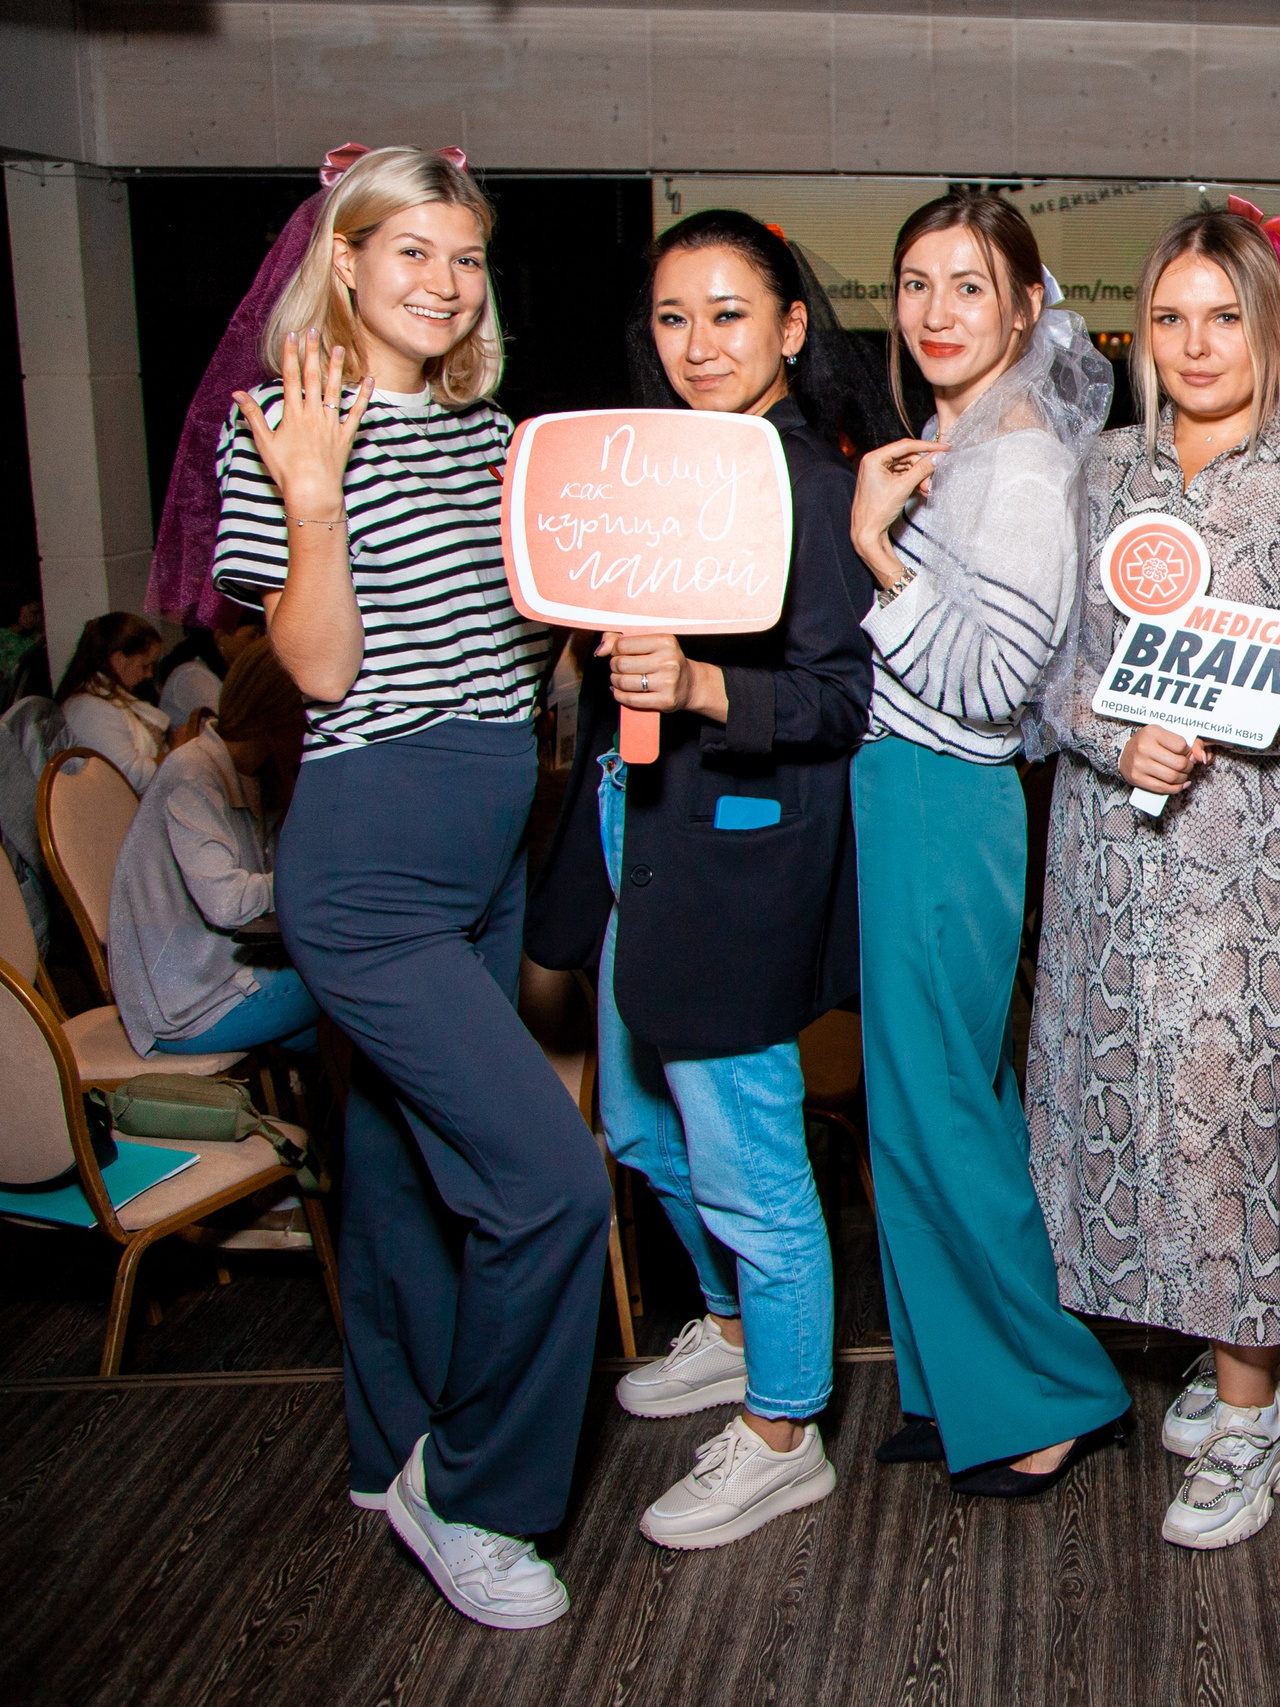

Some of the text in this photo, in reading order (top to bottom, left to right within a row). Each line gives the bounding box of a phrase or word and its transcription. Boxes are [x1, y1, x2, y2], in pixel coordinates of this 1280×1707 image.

[560, 483, 613, 499] как
[601, 425, 748, 540] Пишу
[538, 513, 681, 550] курица
[569, 549, 768, 597] лапой
[1109, 668, 1221, 711] BATTLE
[1101, 700, 1263, 741] первый медицинский квиз
